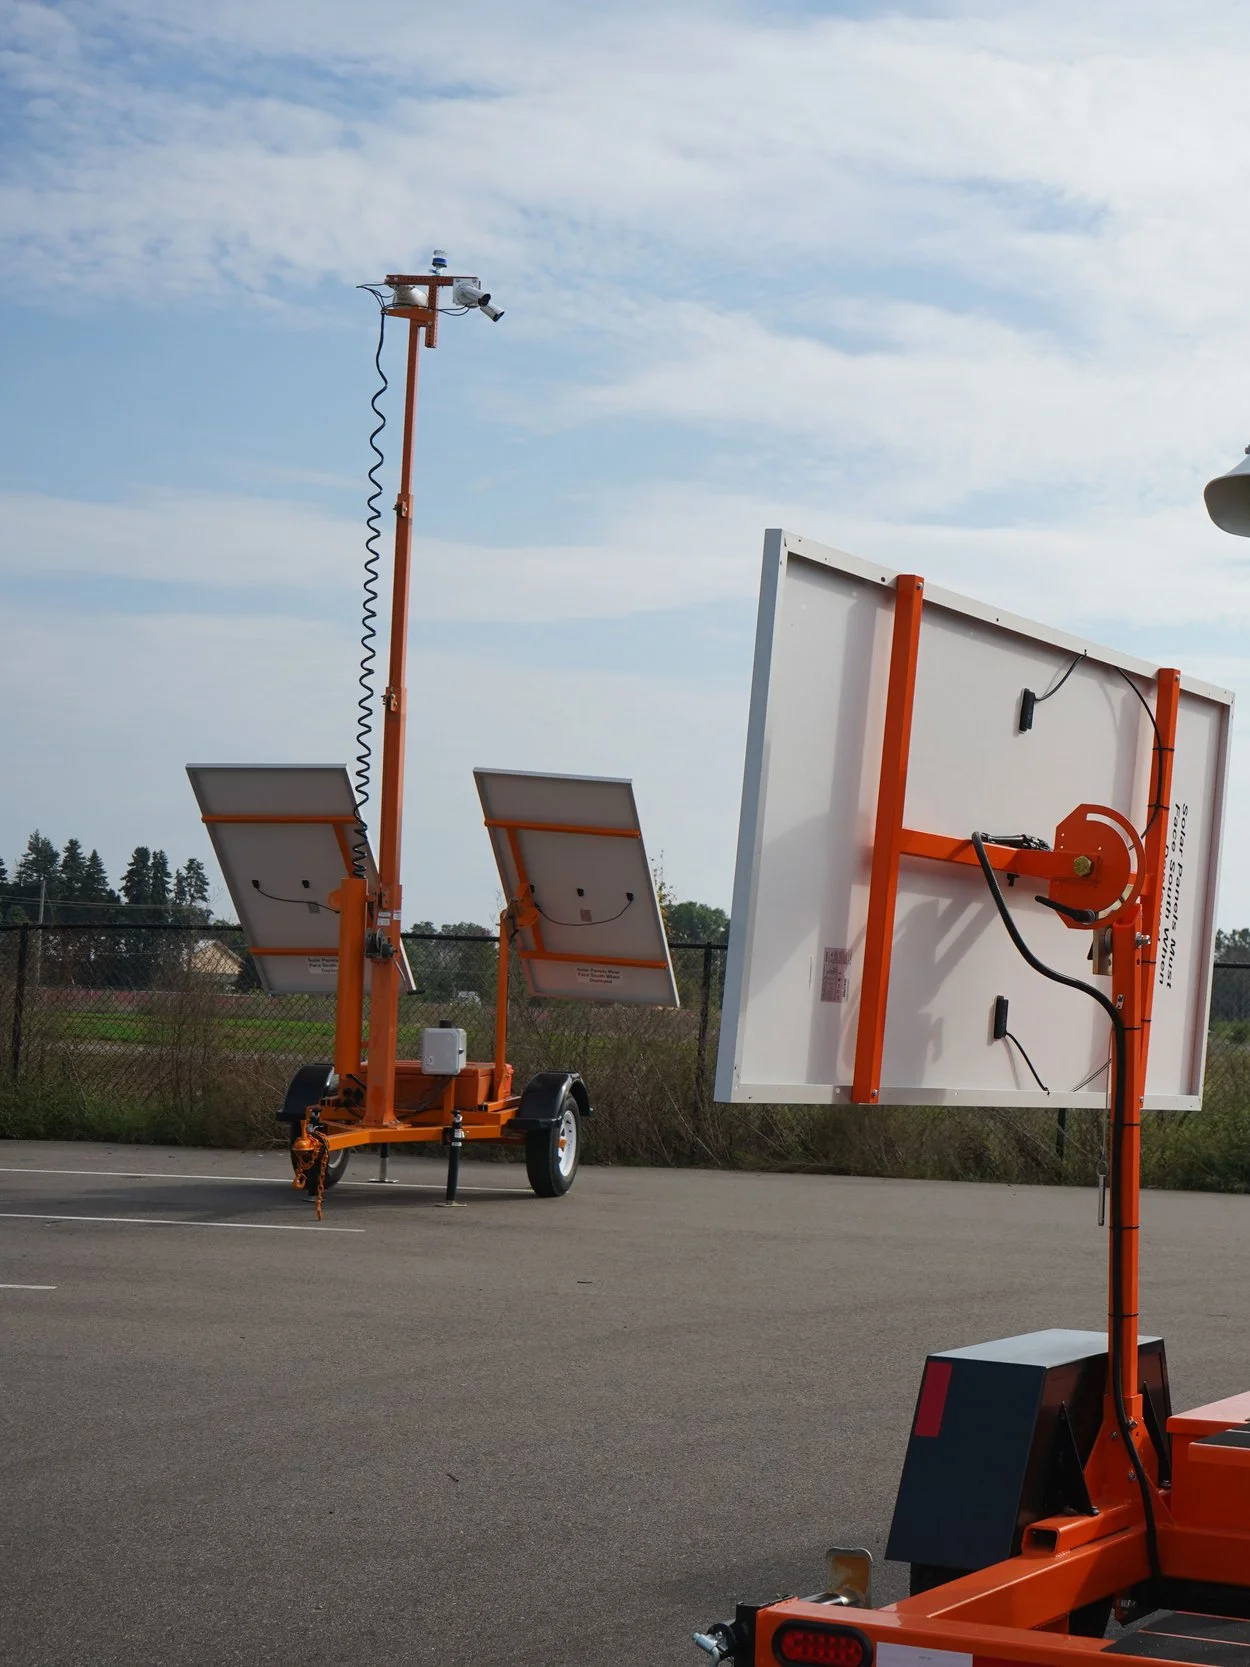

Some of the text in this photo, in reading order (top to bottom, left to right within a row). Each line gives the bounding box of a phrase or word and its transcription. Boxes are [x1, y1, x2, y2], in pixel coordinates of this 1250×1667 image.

[1171, 804, 1180, 852] Face
[1165, 859, 1175, 919] South
[1166, 803, 1188, 989] Solar Panels Must
[1159, 928, 1170, 985] When
